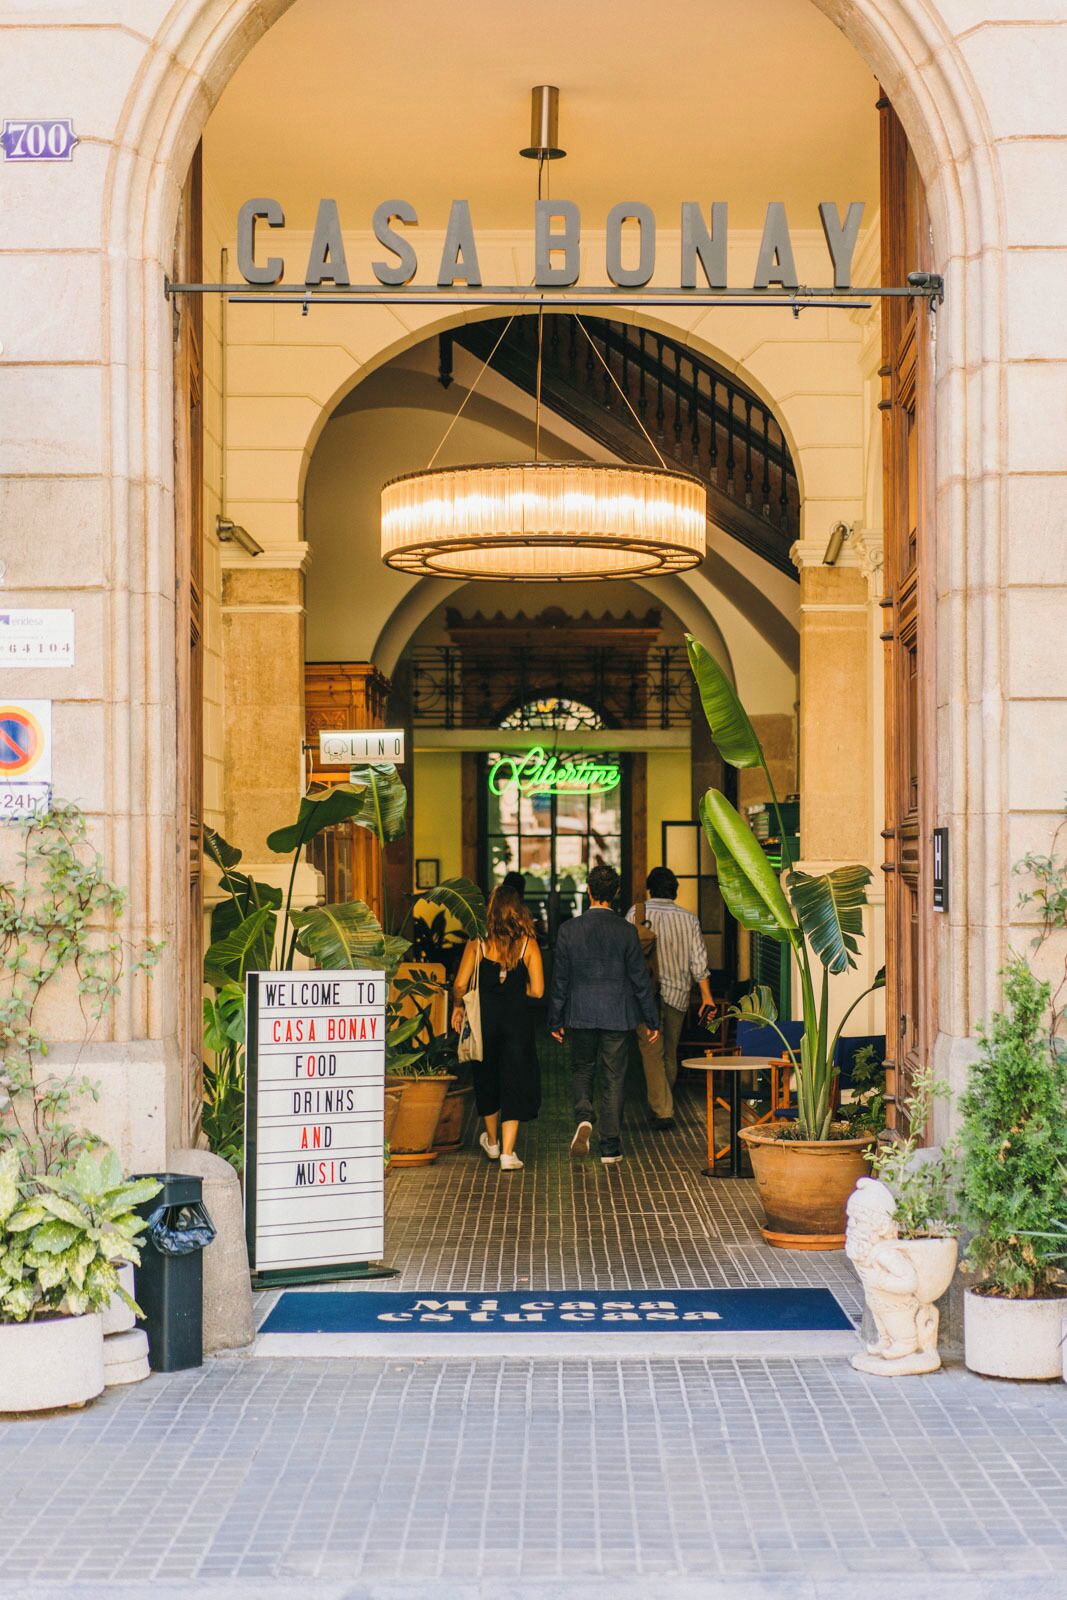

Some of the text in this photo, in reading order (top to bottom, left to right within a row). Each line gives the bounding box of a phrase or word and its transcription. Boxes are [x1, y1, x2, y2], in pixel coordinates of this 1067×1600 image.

[8, 124, 68, 156] 700
[237, 197, 866, 289] CASA BONAY
[350, 738, 401, 756] LINO
[488, 746, 621, 798] Libertine
[266, 982, 375, 1006] WELCOME TO
[273, 1017, 377, 1042] CASA BONAY
[295, 1054, 337, 1078] FOOD
[293, 1089, 354, 1114] DRINKS
[301, 1126, 332, 1149] AND
[295, 1161, 347, 1185] MUSIC
[410, 1300, 679, 1312] Mi casa
[559, 1311, 724, 1322] casa
